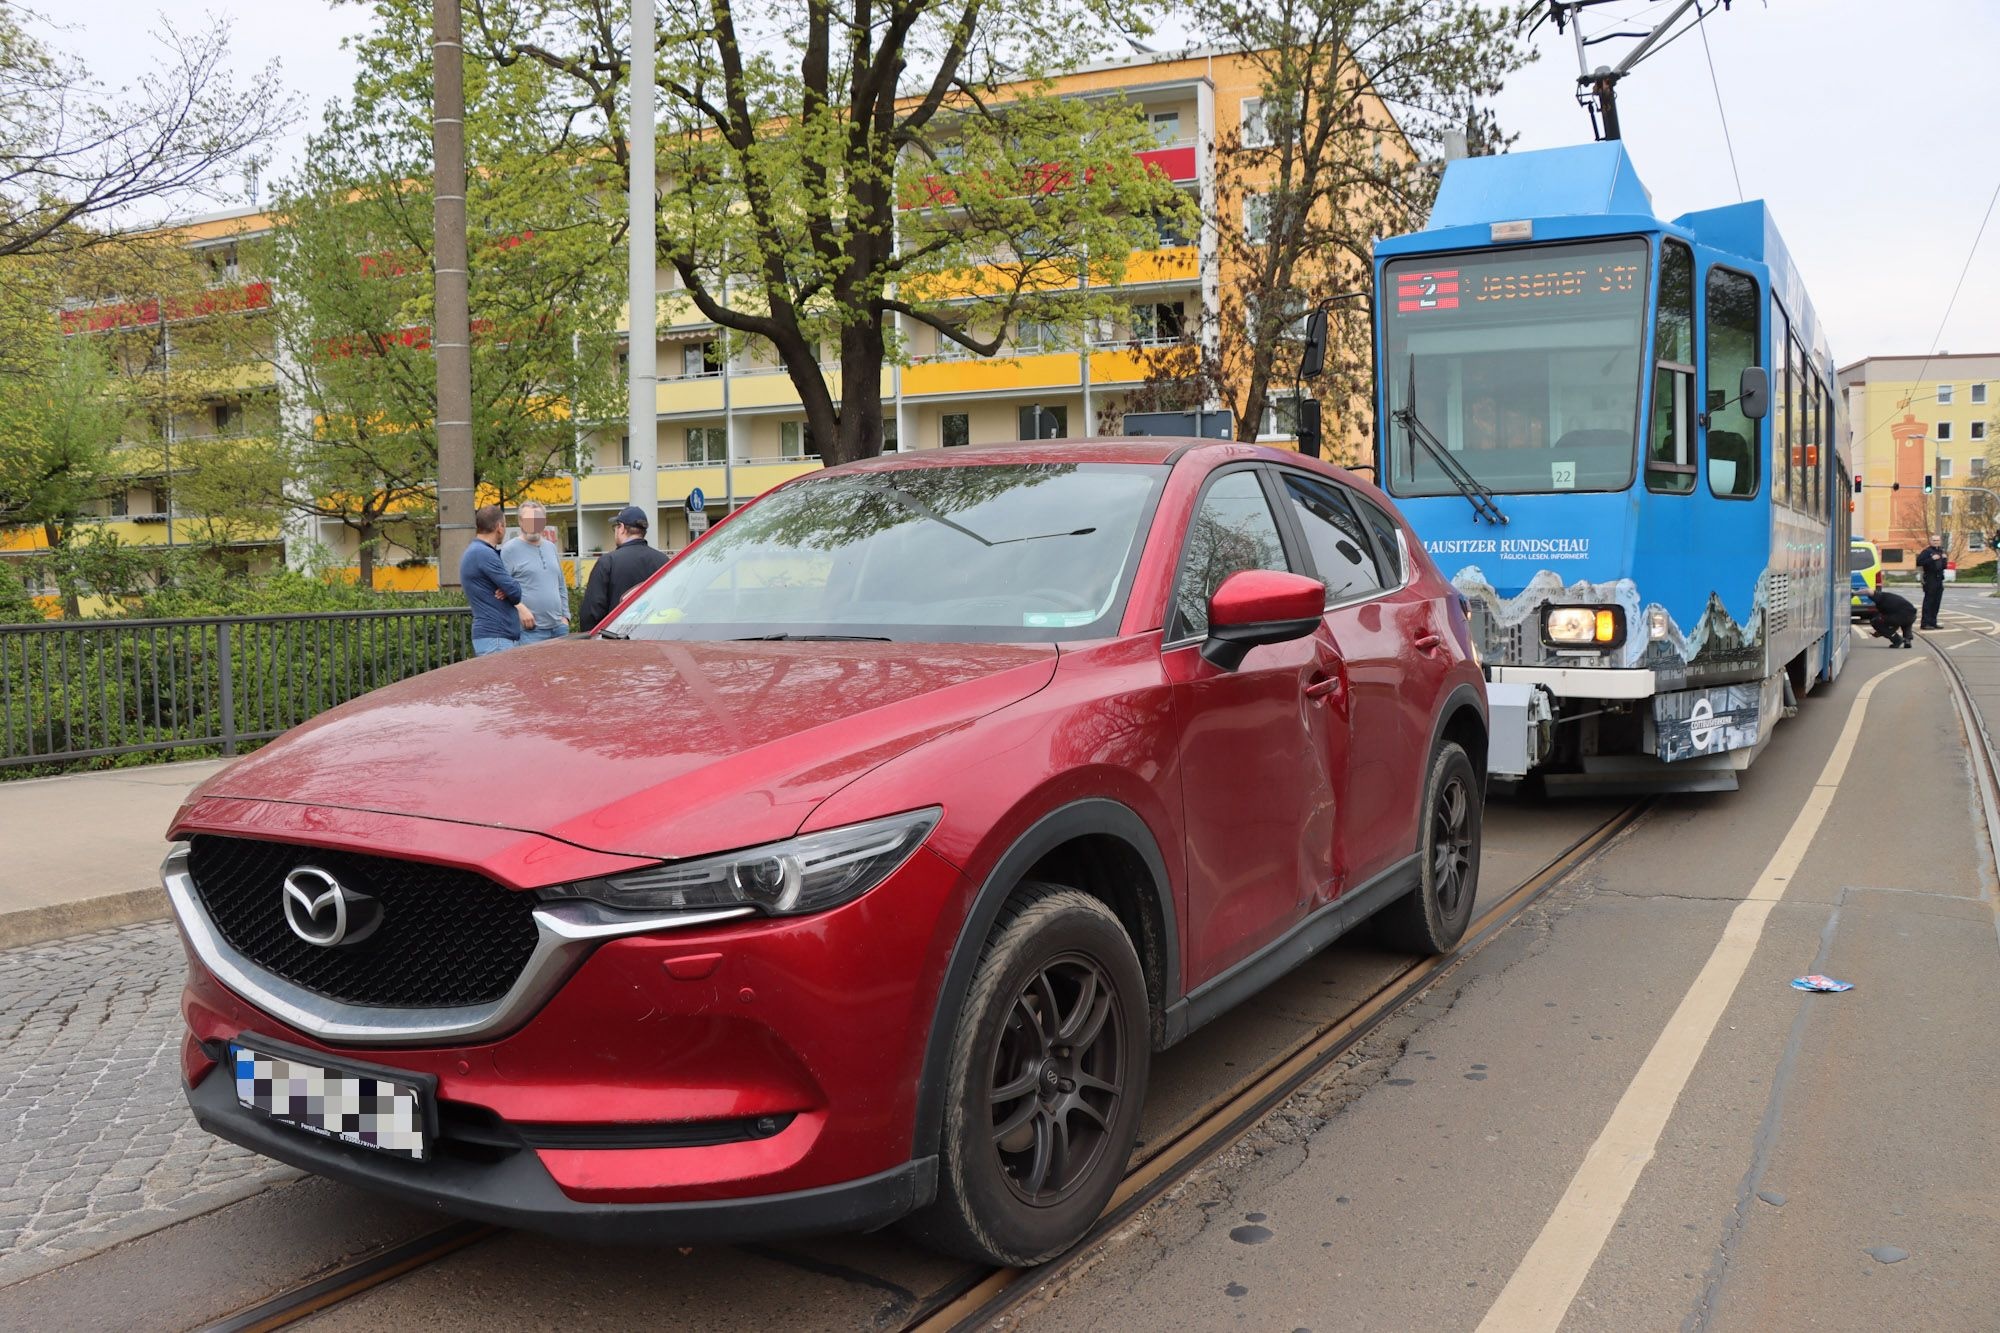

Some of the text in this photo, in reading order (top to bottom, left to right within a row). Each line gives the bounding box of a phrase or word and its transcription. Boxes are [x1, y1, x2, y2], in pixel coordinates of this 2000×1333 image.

[1419, 276, 1437, 306] 2
[1556, 470, 1571, 482] 22
[1500, 538, 1590, 552] RUNDSCHAU
[1551, 552, 1590, 560] INFORMIERT.
